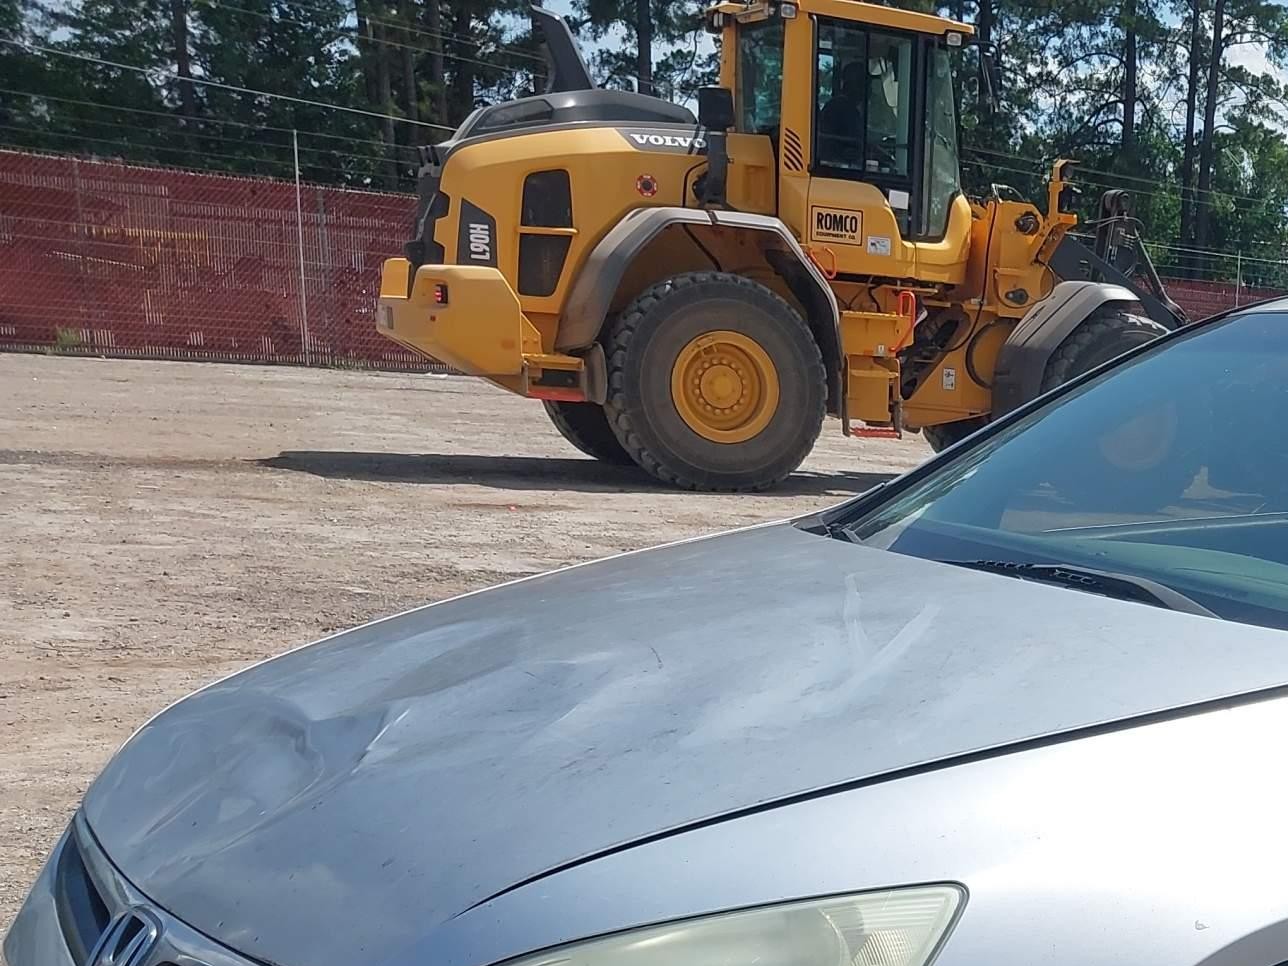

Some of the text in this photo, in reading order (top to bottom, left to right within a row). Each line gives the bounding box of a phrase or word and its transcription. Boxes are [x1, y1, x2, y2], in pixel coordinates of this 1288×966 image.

[630, 133, 707, 149] VOLVO
[816, 211, 858, 234] ROMCO
[468, 223, 491, 261] L90H
